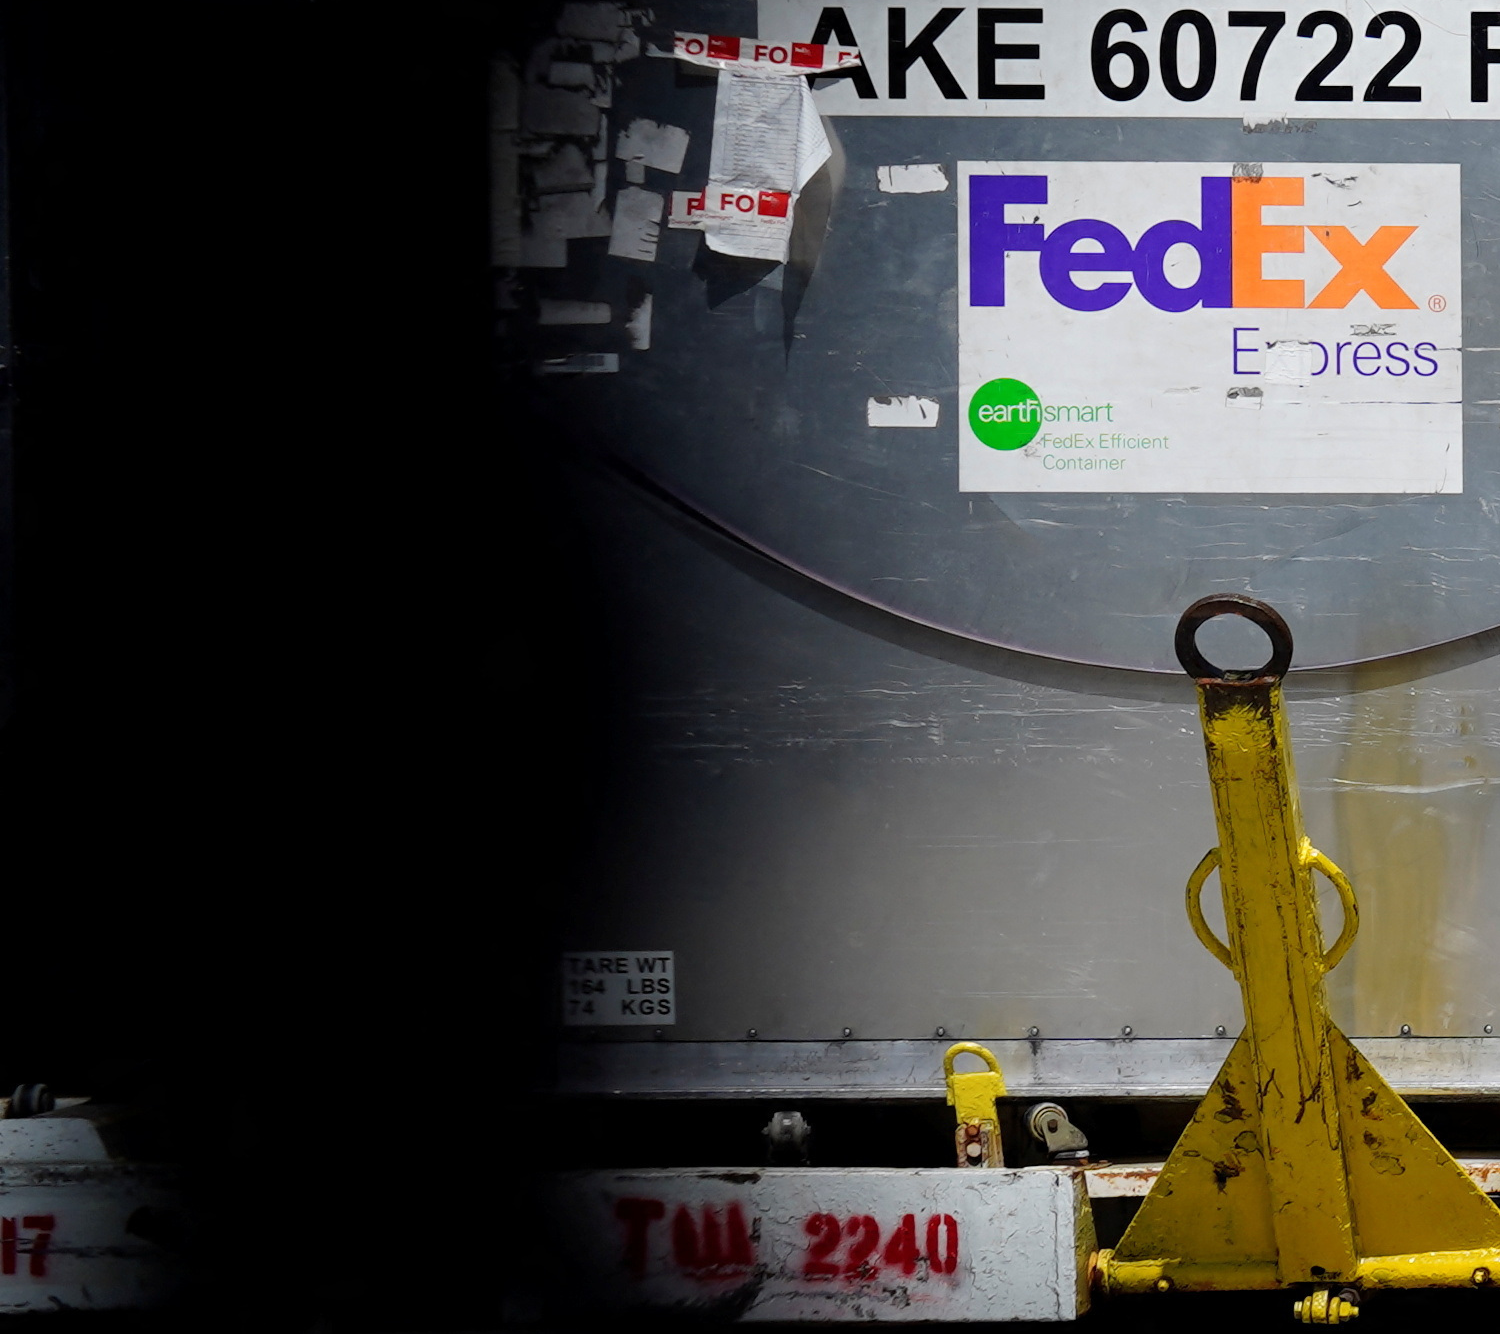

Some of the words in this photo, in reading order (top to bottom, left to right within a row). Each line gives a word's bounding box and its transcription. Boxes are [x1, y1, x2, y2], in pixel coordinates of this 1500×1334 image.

[754, 45, 788, 64] FO
[811, 7, 1046, 101] AKE
[1090, 8, 1423, 104] 60722
[720, 193, 755, 213] FO
[969, 175, 1420, 313] FedEx
[1043, 433, 1094, 449] FedEx
[1099, 432, 1170, 449] Efficient
[1043, 454, 1127, 471] Container
[568, 958, 628, 973] TARE
[636, 957, 671, 973] WT
[627, 978, 670, 994] LBS
[622, 999, 670, 1015] KGS
[802, 1211, 959, 1281] 2240
